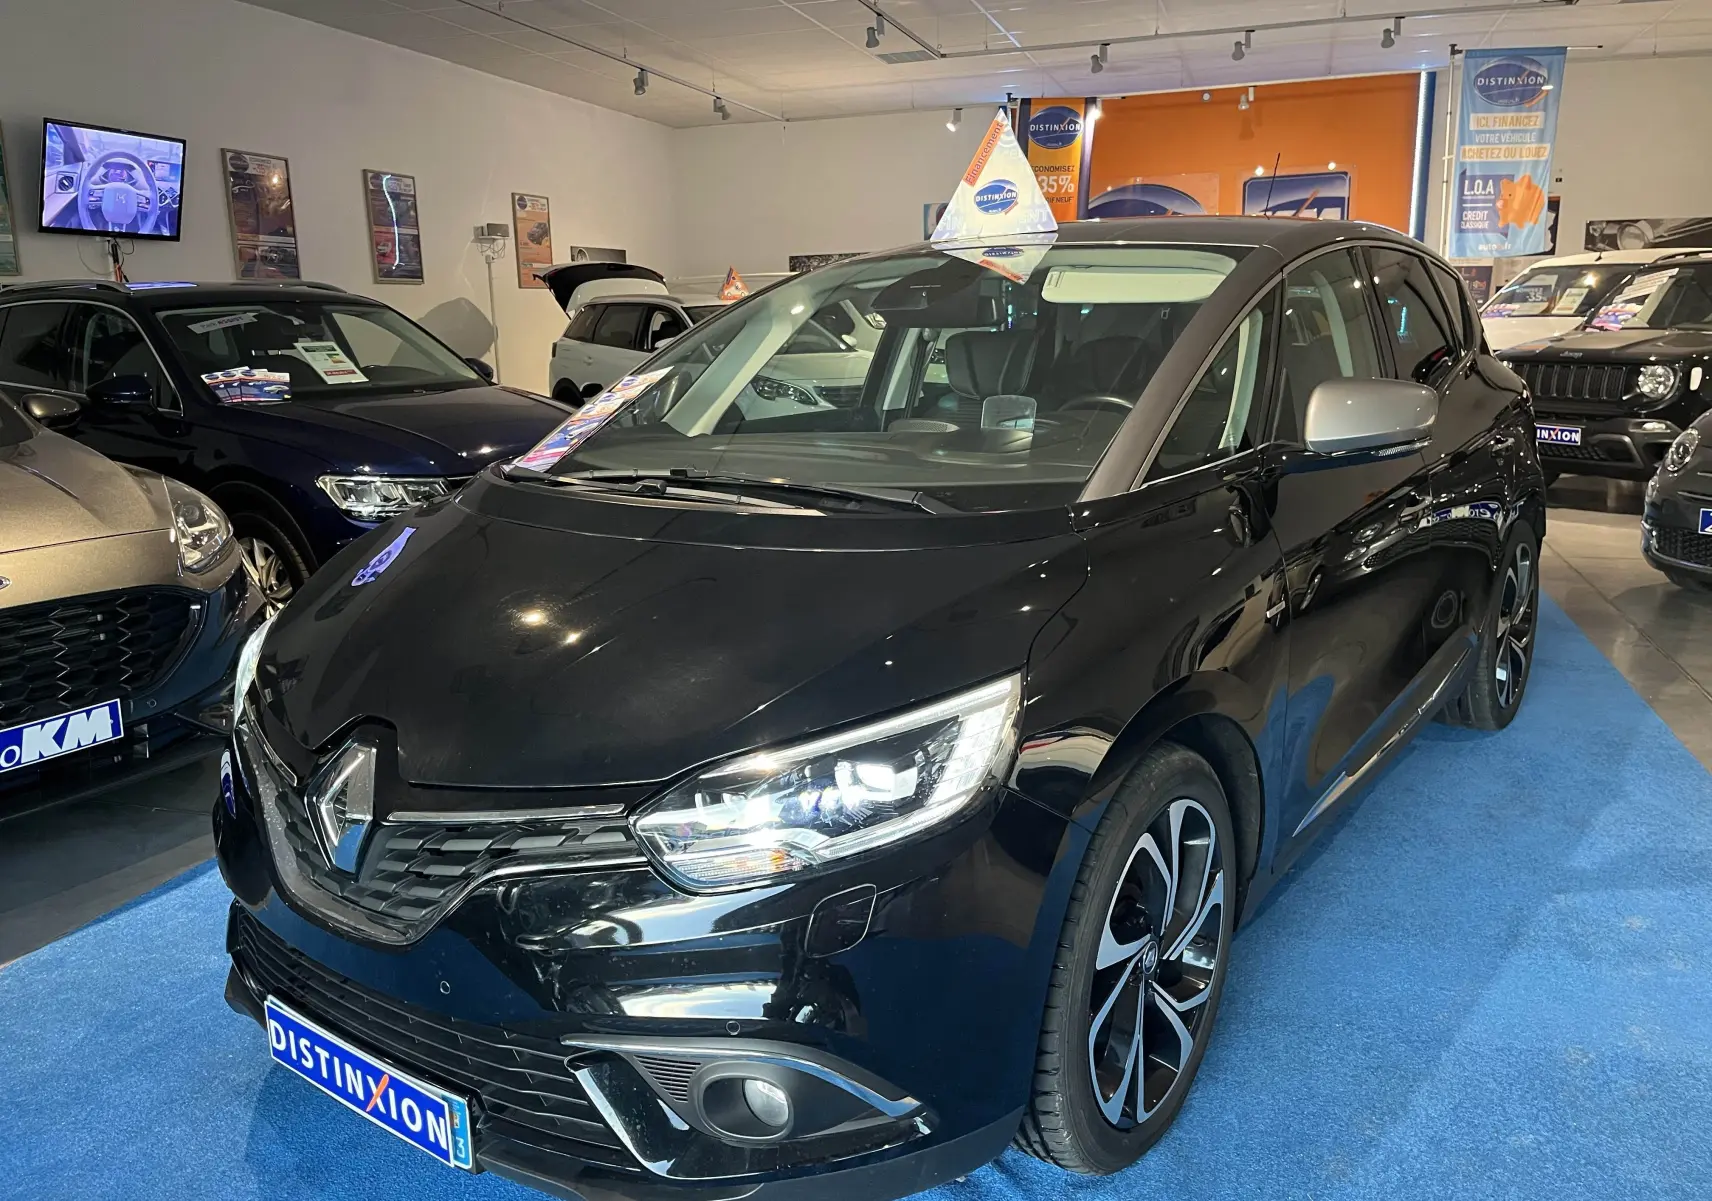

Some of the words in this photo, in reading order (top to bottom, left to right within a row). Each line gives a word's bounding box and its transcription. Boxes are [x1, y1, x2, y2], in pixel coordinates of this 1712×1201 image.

[1477, 74, 1544, 86] DISTINXION
[1029, 122, 1081, 132] DISTINXION
[1492, 115, 1539, 128] FINANCEZ
[1475, 133, 1499, 144] VOTRE
[965, 121, 1003, 184] Financement
[1461, 147, 1501, 160] ACHETEZ
[1503, 147, 1517, 159] OU
[1463, 179, 1495, 195] L.O.A
[975, 191, 1017, 202] DISTINXION
[1536, 428, 1580, 442] INXION
[269, 1018, 448, 1151] DISTINXION
